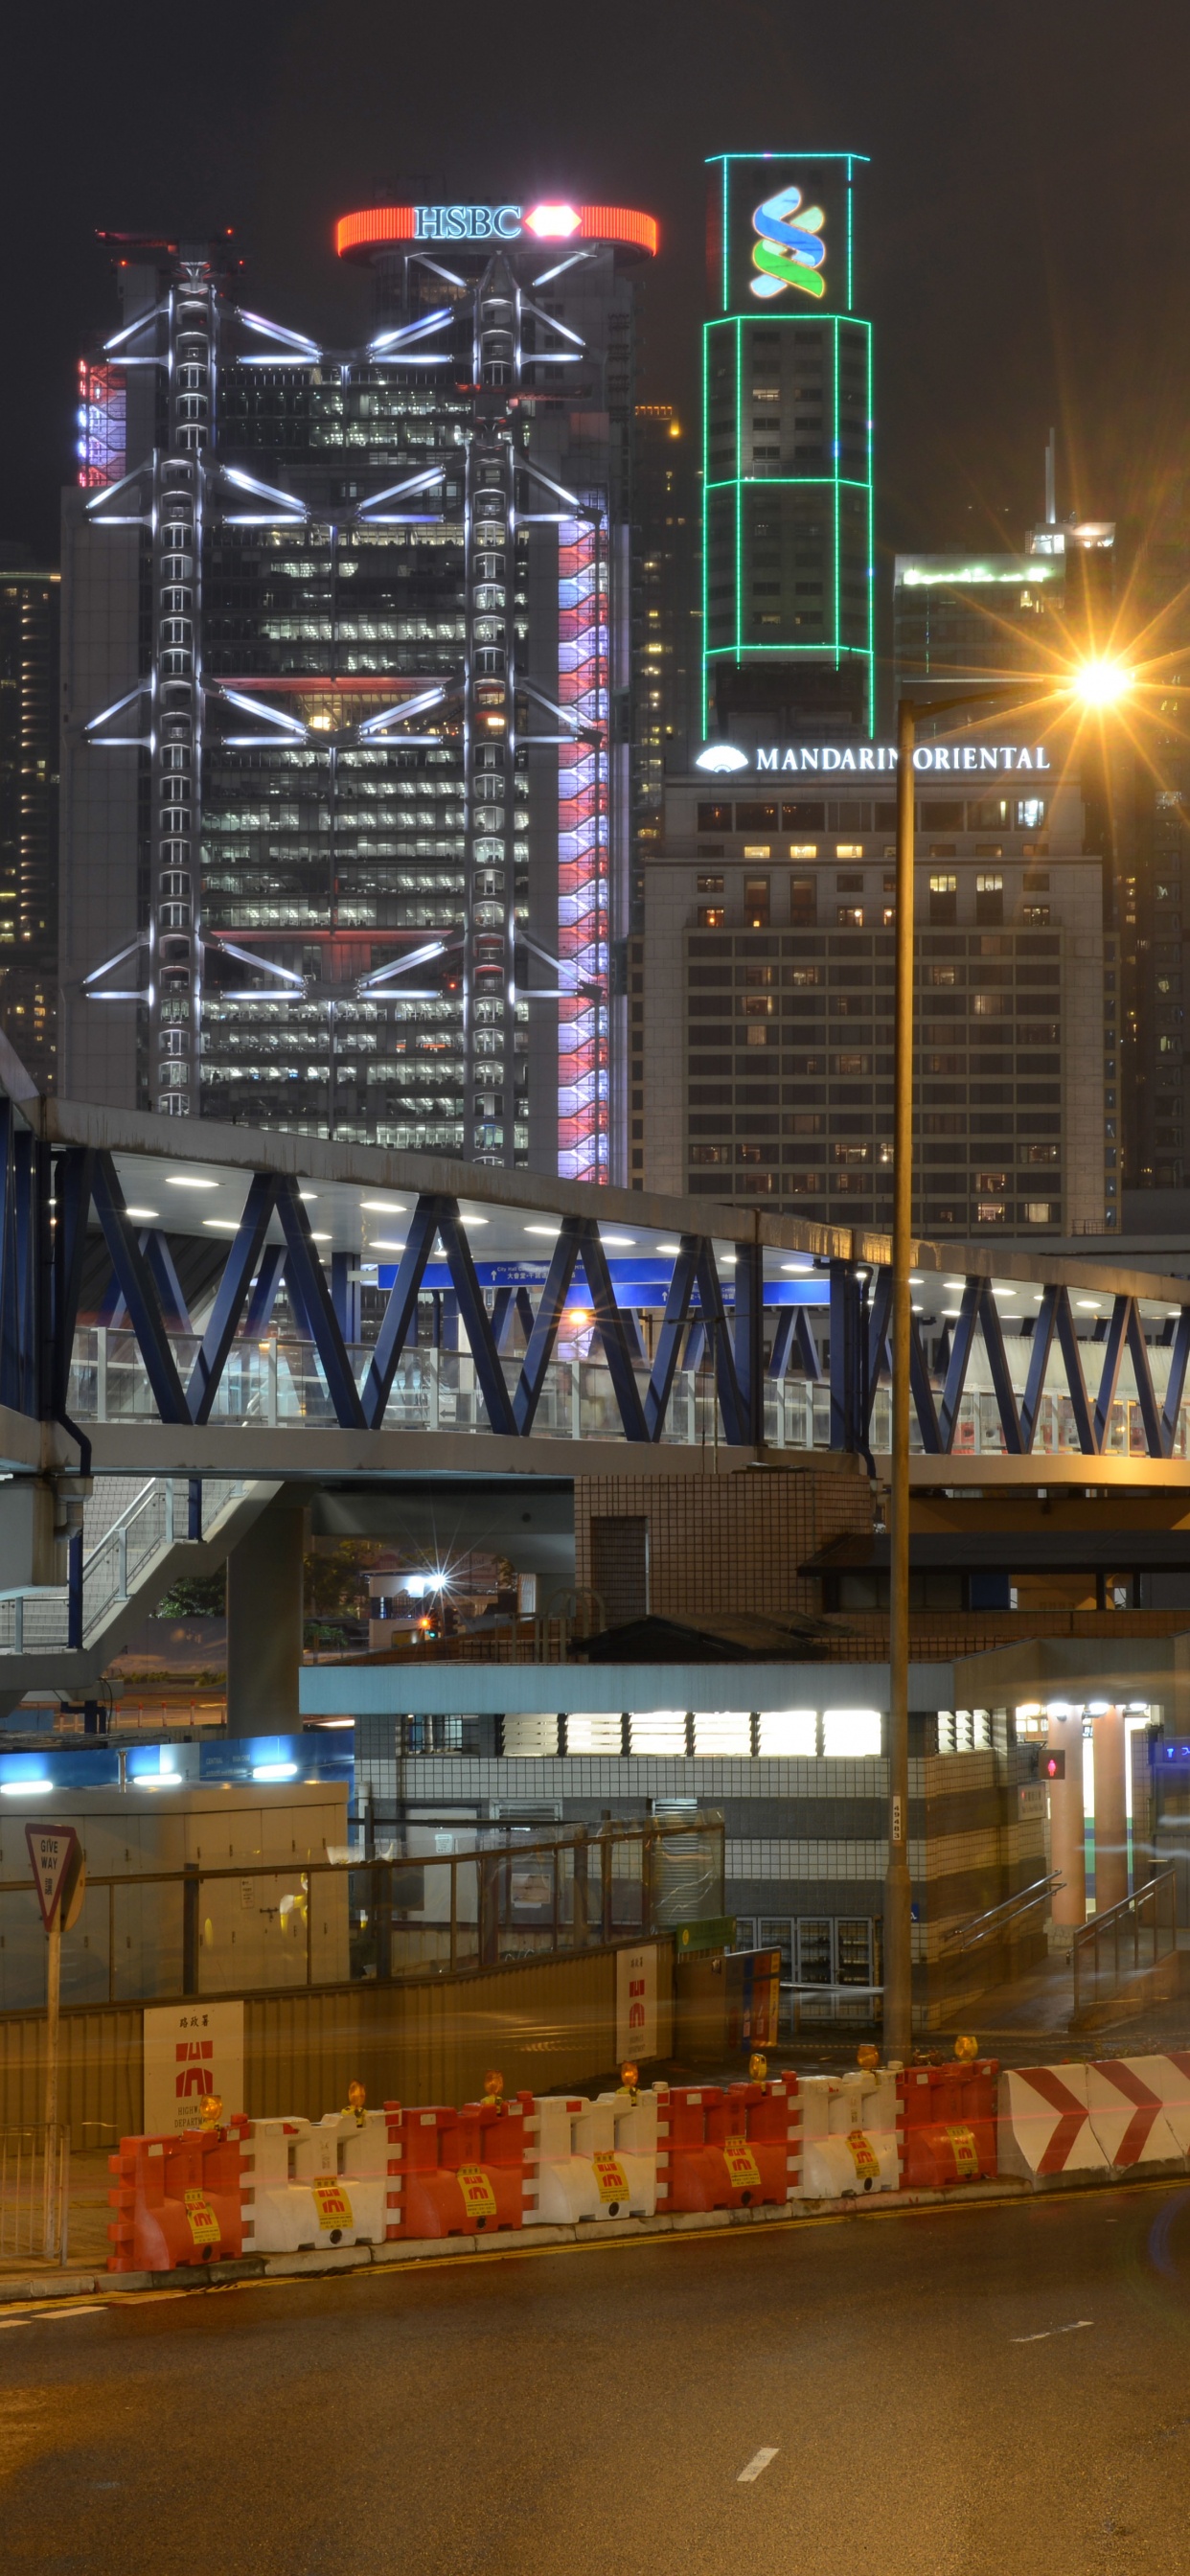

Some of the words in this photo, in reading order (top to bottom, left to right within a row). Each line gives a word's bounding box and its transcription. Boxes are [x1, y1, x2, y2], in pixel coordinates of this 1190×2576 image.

[414, 206, 522, 239] HSBC
[913, 747, 1050, 770] ORIENTAL
[40, 1838, 59, 1853] GIVE
[41, 1856, 57, 1870] WAY
[179, 2014, 210, 2029] 路政署
[177, 2105, 201, 2116] HIGHW
[173, 2116, 206, 2128] DEPARTM
